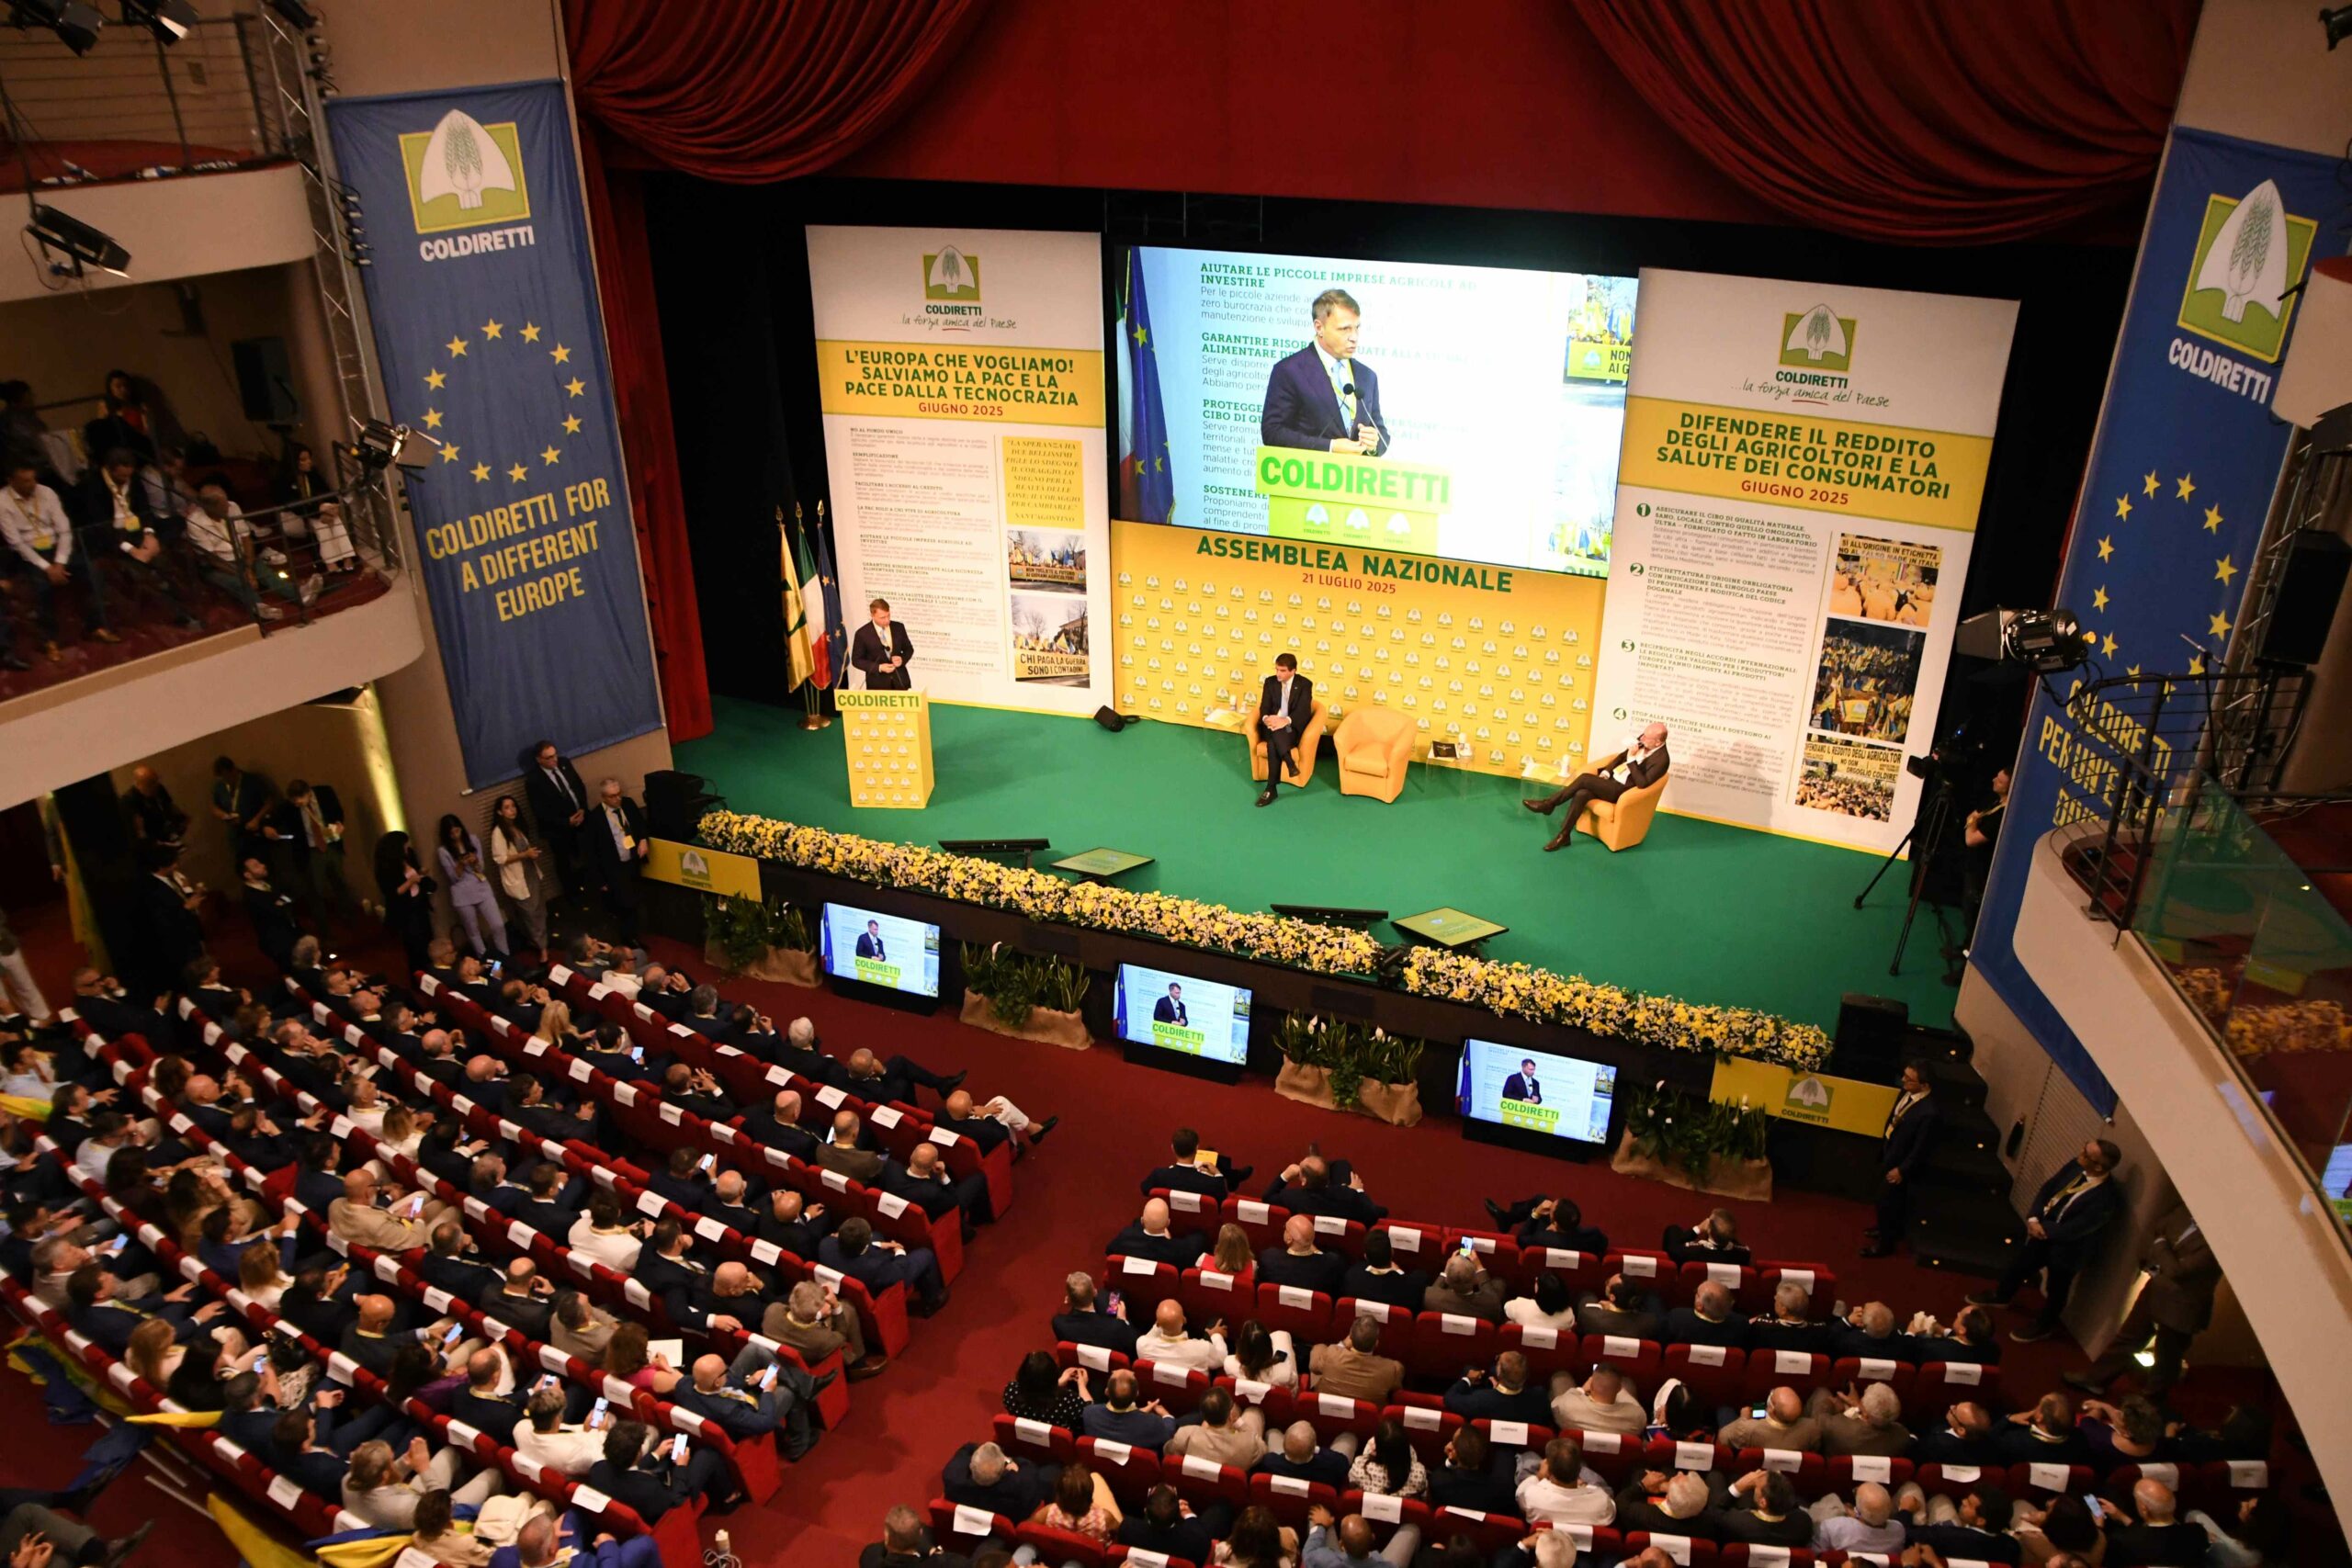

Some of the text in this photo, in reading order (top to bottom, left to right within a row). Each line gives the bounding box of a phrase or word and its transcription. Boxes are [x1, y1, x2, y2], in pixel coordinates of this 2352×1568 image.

[420, 225, 535, 263] COLDIRETTI
[1200, 263, 1252, 275] AIUTARE
[1257, 266, 1270, 276] LE
[1274, 267, 1327, 280] PICCOLE
[1329, 271, 1385, 284] IMPRESE
[1200, 275, 1264, 288] INVESTIRE
[1201, 287, 1215, 296] Per
[1218, 288, 1227, 297] le
[1229, 288, 1261, 300] piccole
[1264, 291, 1301, 302] aziende
[925, 305, 981, 315] COLDIRETTI
[1201, 299, 1220, 308] zero
[1224, 299, 1272, 311] burocrazia
[1274, 303, 1292, 313] che
[942, 316, 968, 326] amica
[972, 316, 986, 327] del
[1201, 310, 1266, 323] manutenzione
[1201, 332, 1309, 349] GARANTIRE RISOR
[1202, 344, 1276, 357] ALIMENTARE
[845, 350, 1073, 373] L'EUROPA CHE VOGLIAMO!
[1202, 355, 1268, 369] Serve disporre
[862, 367, 1057, 388] SALVIAMO LA PAC E LA
[1202, 366, 1270, 380] degli agricoltor
[2168, 337, 2270, 405] COLDIRETTI
[1202, 377, 1243, 389] Abbiamo
[1775, 370, 1848, 389] COLDIRETTI
[844, 381, 1078, 405] PACE DALLA TECNOCRAZIA
[1757, 381, 1790, 400] forza
[1793, 387, 1828, 400] amica
[1832, 388, 1852, 402] del
[918, 402, 1002, 416] GIUGNO 2025
[1203, 399, 1263, 412] PROTEGGE
[1203, 410, 1230, 420] CIBO
[1234, 413, 1245, 422] DI
[1203, 421, 1227, 431] Serve
[1203, 432, 1245, 444] territoriali
[1679, 412, 1936, 458] DIFENDERE IL REDDITO
[1203, 444, 1231, 453] mense
[1666, 429, 1939, 479] DEGLI AGRICOLTORI E LA
[1203, 453, 1238, 464] malattie
[1203, 465, 1251, 477] aumento di
[1657, 446, 1951, 499] SALUTE DEI CONSUMATORI
[1259, 456, 1450, 503] COLDIRETTI
[1740, 479, 1849, 505] GIUGNO 2025
[1203, 494, 1256, 509] Proponiamo
[425, 478, 610, 559] COLDIRETTI FOR
[1203, 506, 1264, 520] comprendenti
[1214, 517, 1229, 526] fine
[1232, 519, 1240, 527] di
[462, 521, 599, 592] A DIFFERENT
[1849, 540, 1891, 552] ALL'ORIGINE
[1901, 548, 1938, 559] ETICHETTA
[1197, 536, 1512, 592] ASSEMBLEA NAZIONALE
[1917, 559, 1939, 568] ITALY
[1302, 572, 1396, 595] 21 LUGLIO 2025
[496, 567, 584, 622] EUROPE
[1020, 653, 1035, 664] CHI
[1037, 655, 1055, 664] PAGA
[1027, 664, 1048, 675] SONO
[1054, 665, 1083, 674] CONTADINI
[837, 694, 920, 707] COLDIRETTI
[1831, 745, 1851, 757] REDDITO
[1851, 748, 1866, 759] DEGLI
[1866, 749, 1901, 764] AGRICOLTOR
[1846, 766, 1871, 776] ORGOGLIO
[1872, 771, 1897, 781] COLDIRE
[855, 958, 900, 976] COLDIRETTI
[1152, 1023, 1204, 1042] COLDIRETTI
[1499, 1100, 1559, 1120] COLDIRETTI
[1781, 1109, 1829, 1123] COLDIRETTI
